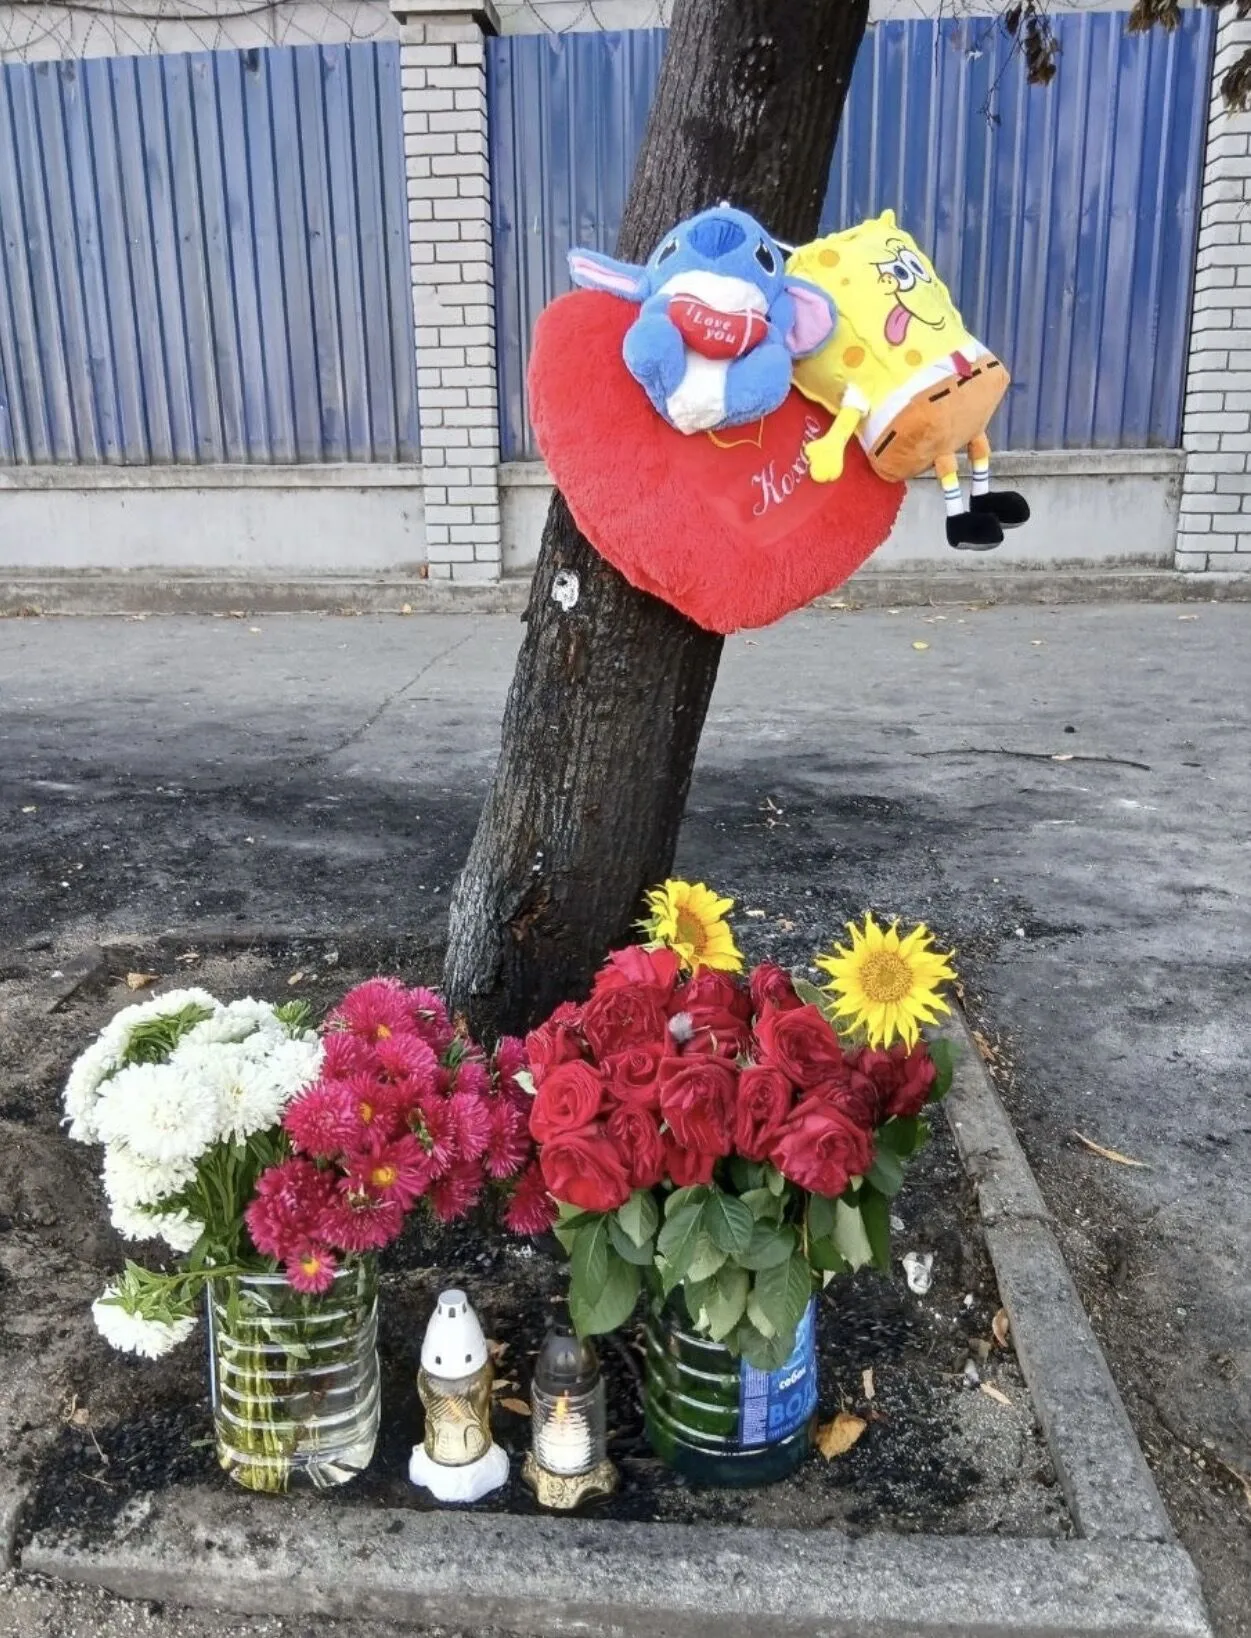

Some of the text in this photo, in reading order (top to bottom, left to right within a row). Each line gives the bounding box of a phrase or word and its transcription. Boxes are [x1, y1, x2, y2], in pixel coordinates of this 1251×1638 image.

[686, 304, 732, 331] I Love
[703, 328, 736, 345] you
